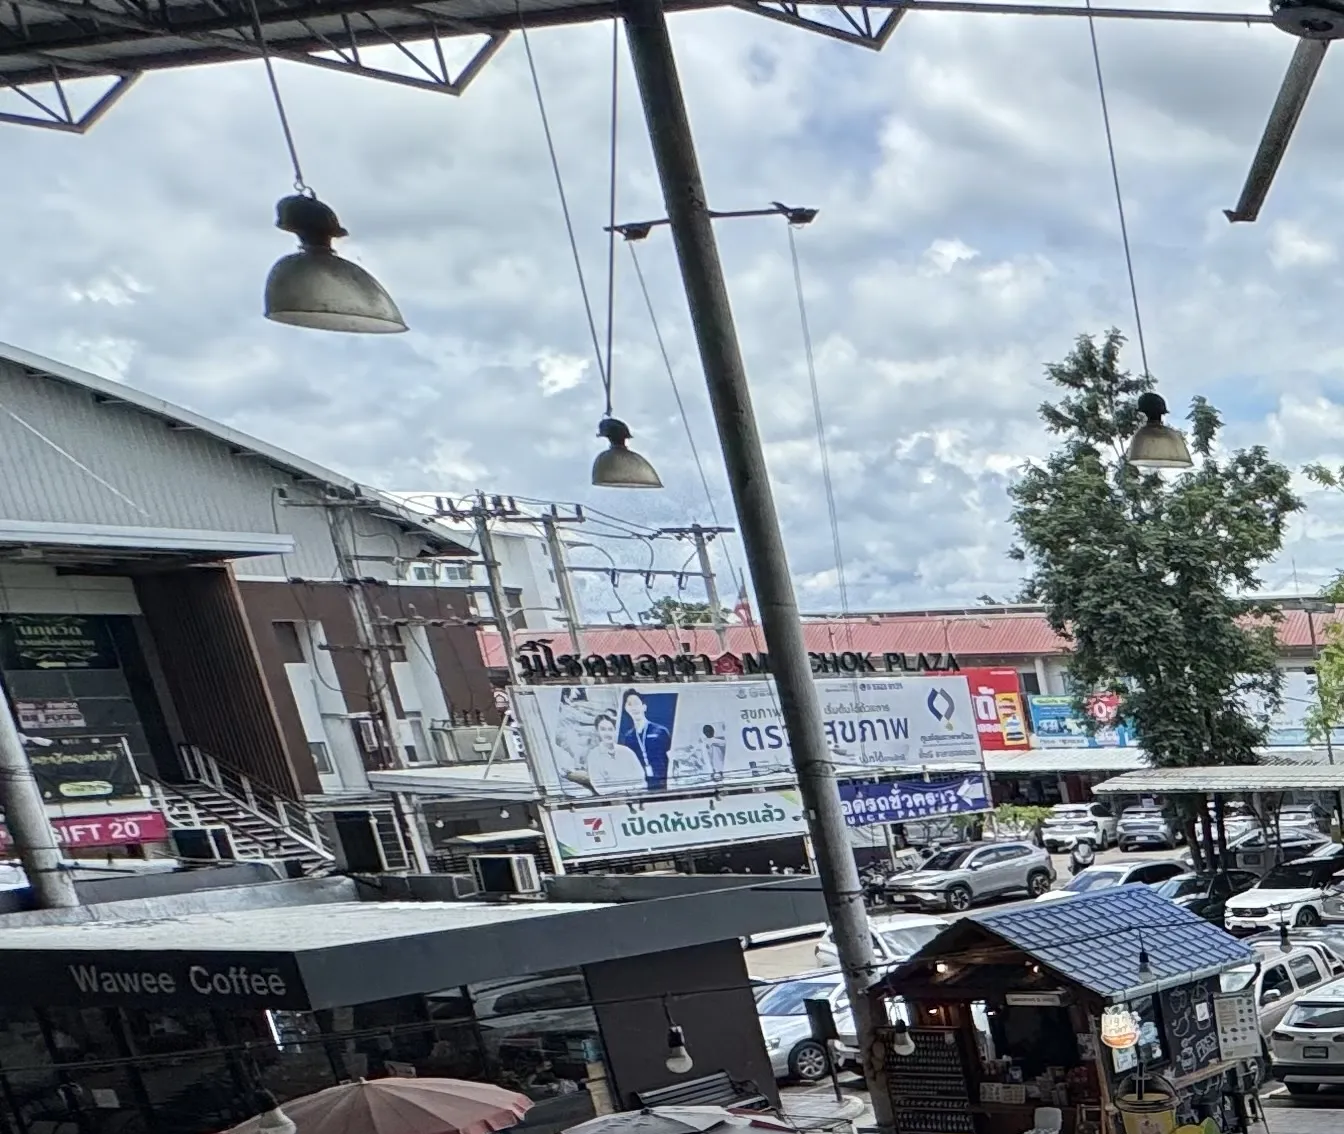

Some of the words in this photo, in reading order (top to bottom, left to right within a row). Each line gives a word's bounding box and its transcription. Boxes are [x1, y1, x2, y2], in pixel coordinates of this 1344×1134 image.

[883, 652, 960, 673] PLAZA
[841, 783, 956, 816] อดรถชั่วคราว
[109, 821, 140, 839] 20
[621, 803, 786, 837] เปิดให้บริการแล้ว
[847, 814, 886, 827] UICK
[68, 965, 176, 994] Wawee
[189, 965, 286, 996] Coffee
